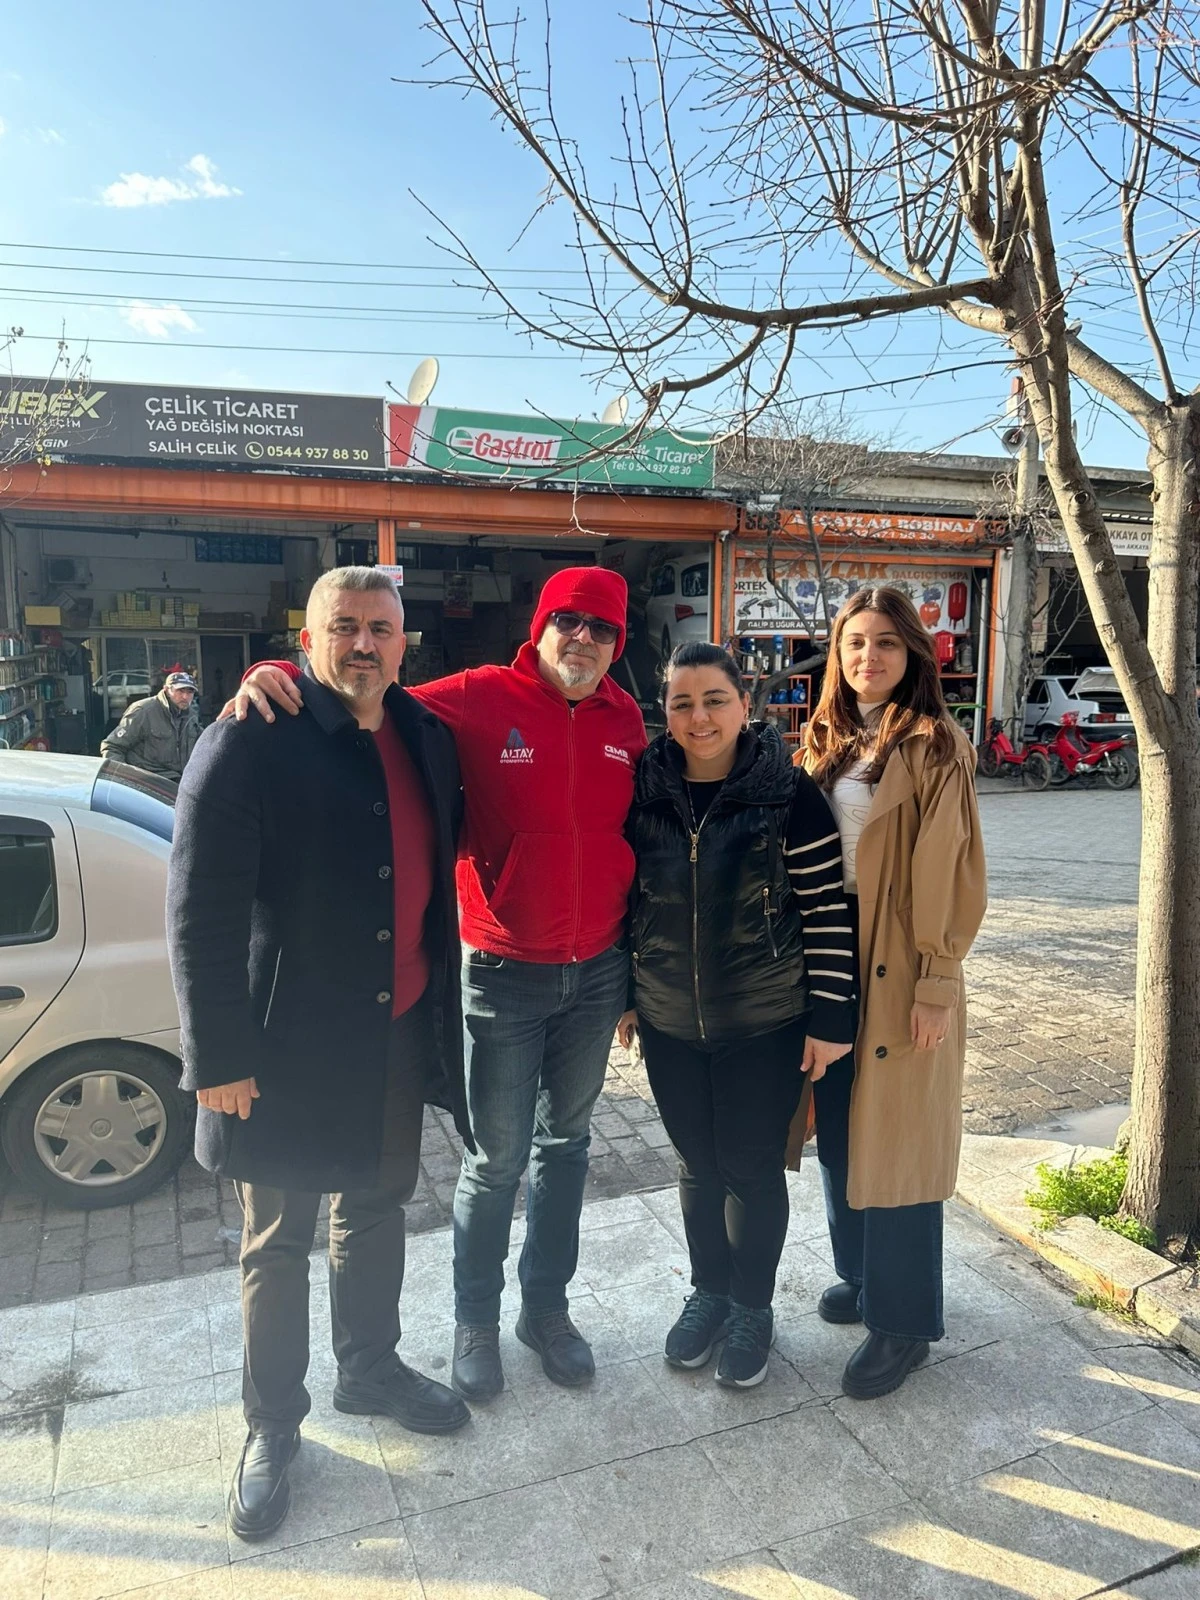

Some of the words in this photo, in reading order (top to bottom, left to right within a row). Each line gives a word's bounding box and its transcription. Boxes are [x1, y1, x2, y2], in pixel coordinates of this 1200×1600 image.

[145, 394, 208, 417] ÇELİK
[212, 396, 299, 420] TİCARET
[146, 418, 177, 432] YAĞ
[181, 419, 238, 436] DEĞİŞİM
[243, 423, 304, 437] NOKTASI
[148, 439, 192, 454] SALİH
[195, 441, 238, 458] ÇELİK
[267, 445, 302, 458] 0544
[305, 447, 329, 460] 937
[332, 448, 349, 460] 88
[352, 449, 369, 461] 30
[474, 432, 554, 461] Castrol
[655, 446, 704, 465] Ticaret
[500, 748, 535, 759] ALTAY
